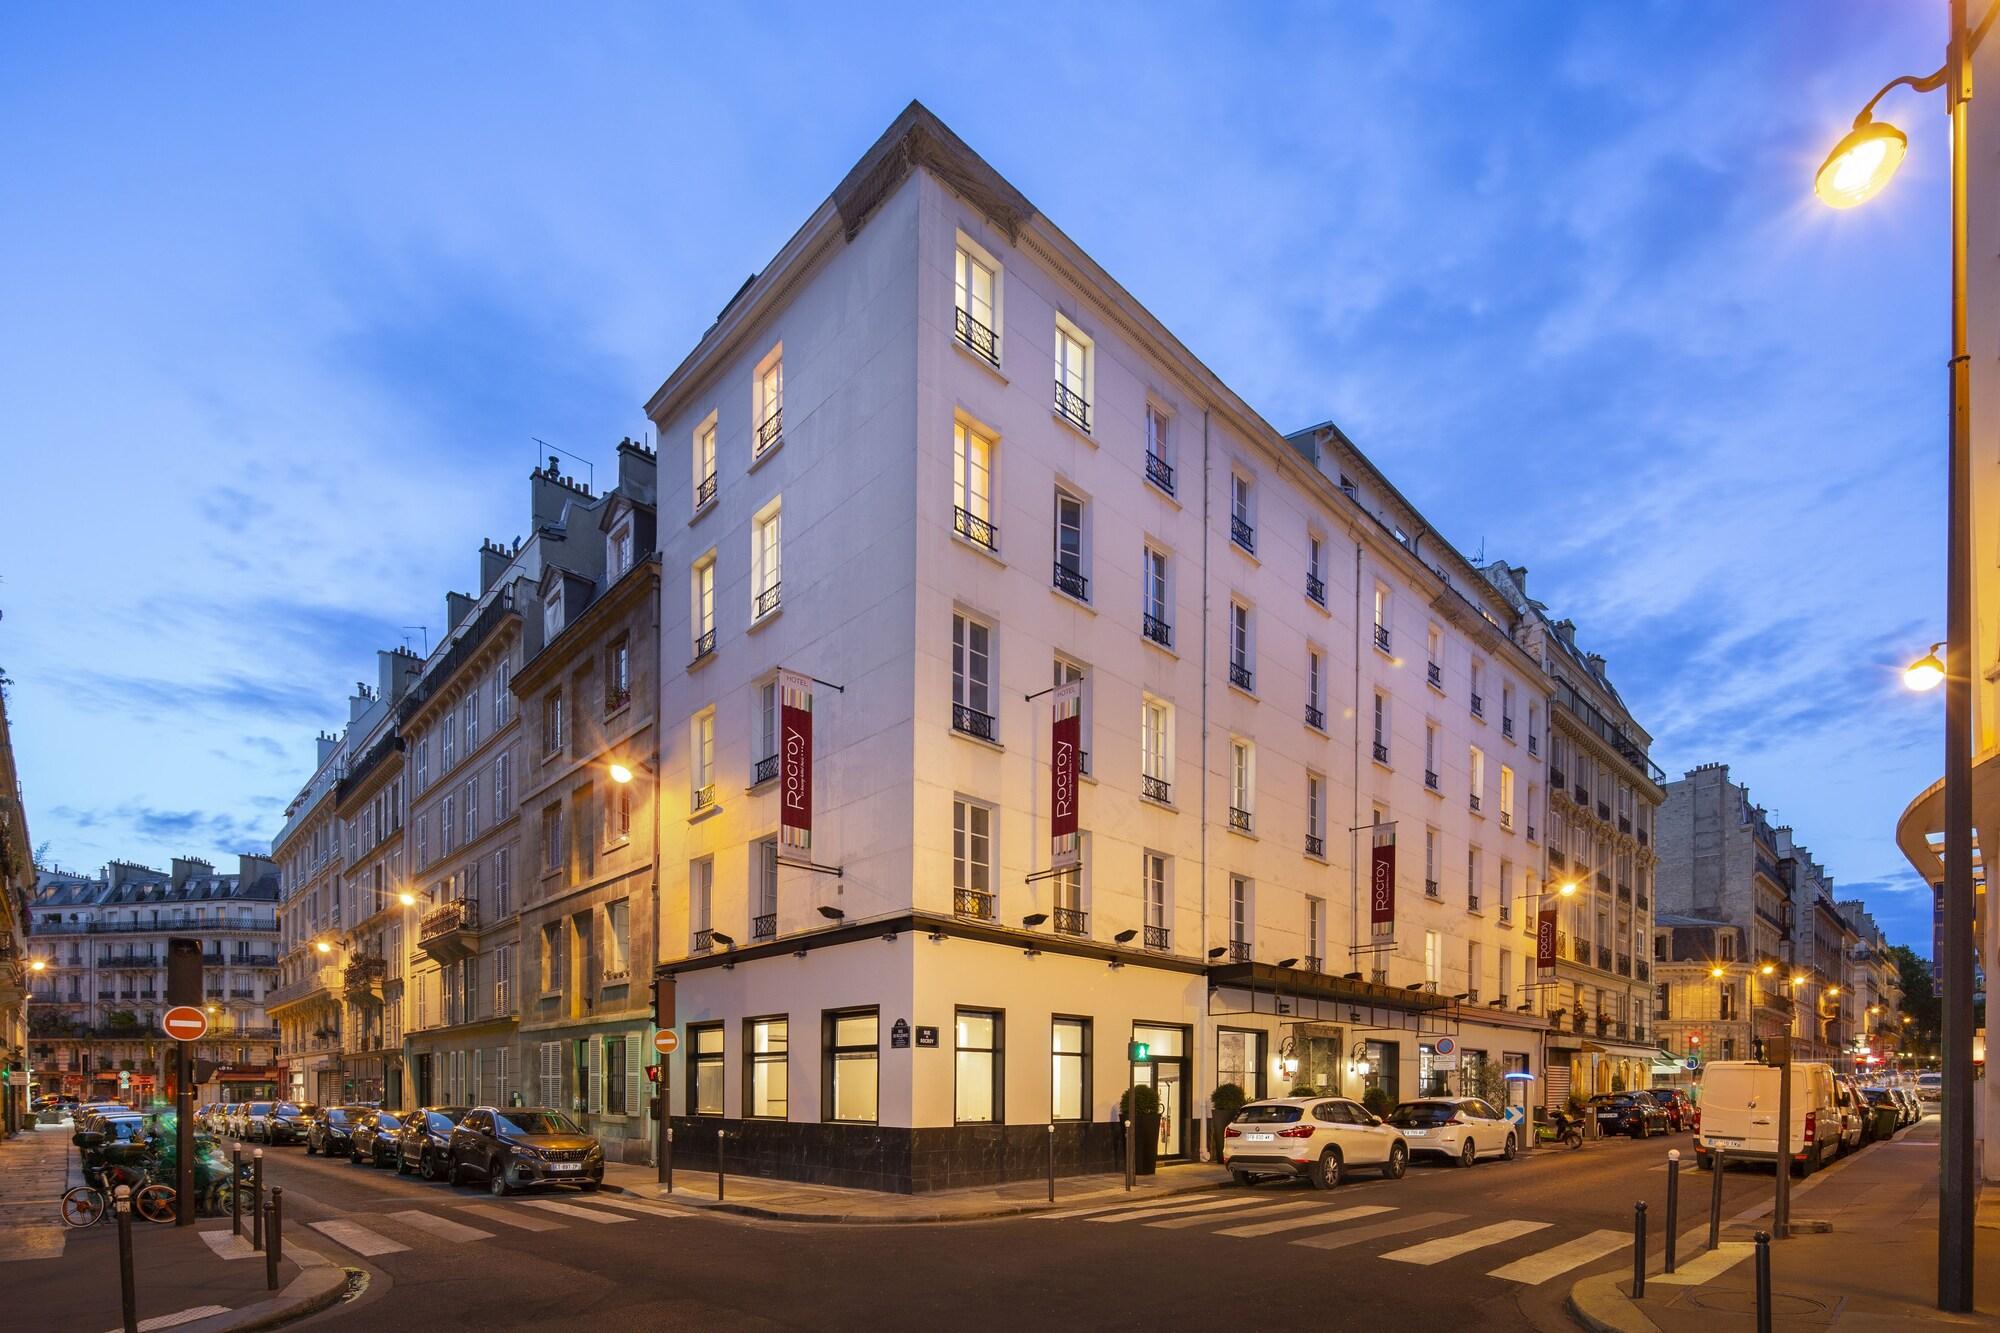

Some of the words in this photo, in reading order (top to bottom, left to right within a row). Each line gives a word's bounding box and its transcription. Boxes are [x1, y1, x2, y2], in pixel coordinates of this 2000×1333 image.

[786, 726, 805, 810] Rocroy
[1056, 740, 1073, 818] Rocroy
[1375, 859, 1390, 911] Rocroy
[1540, 920, 1552, 959] Rocroy
